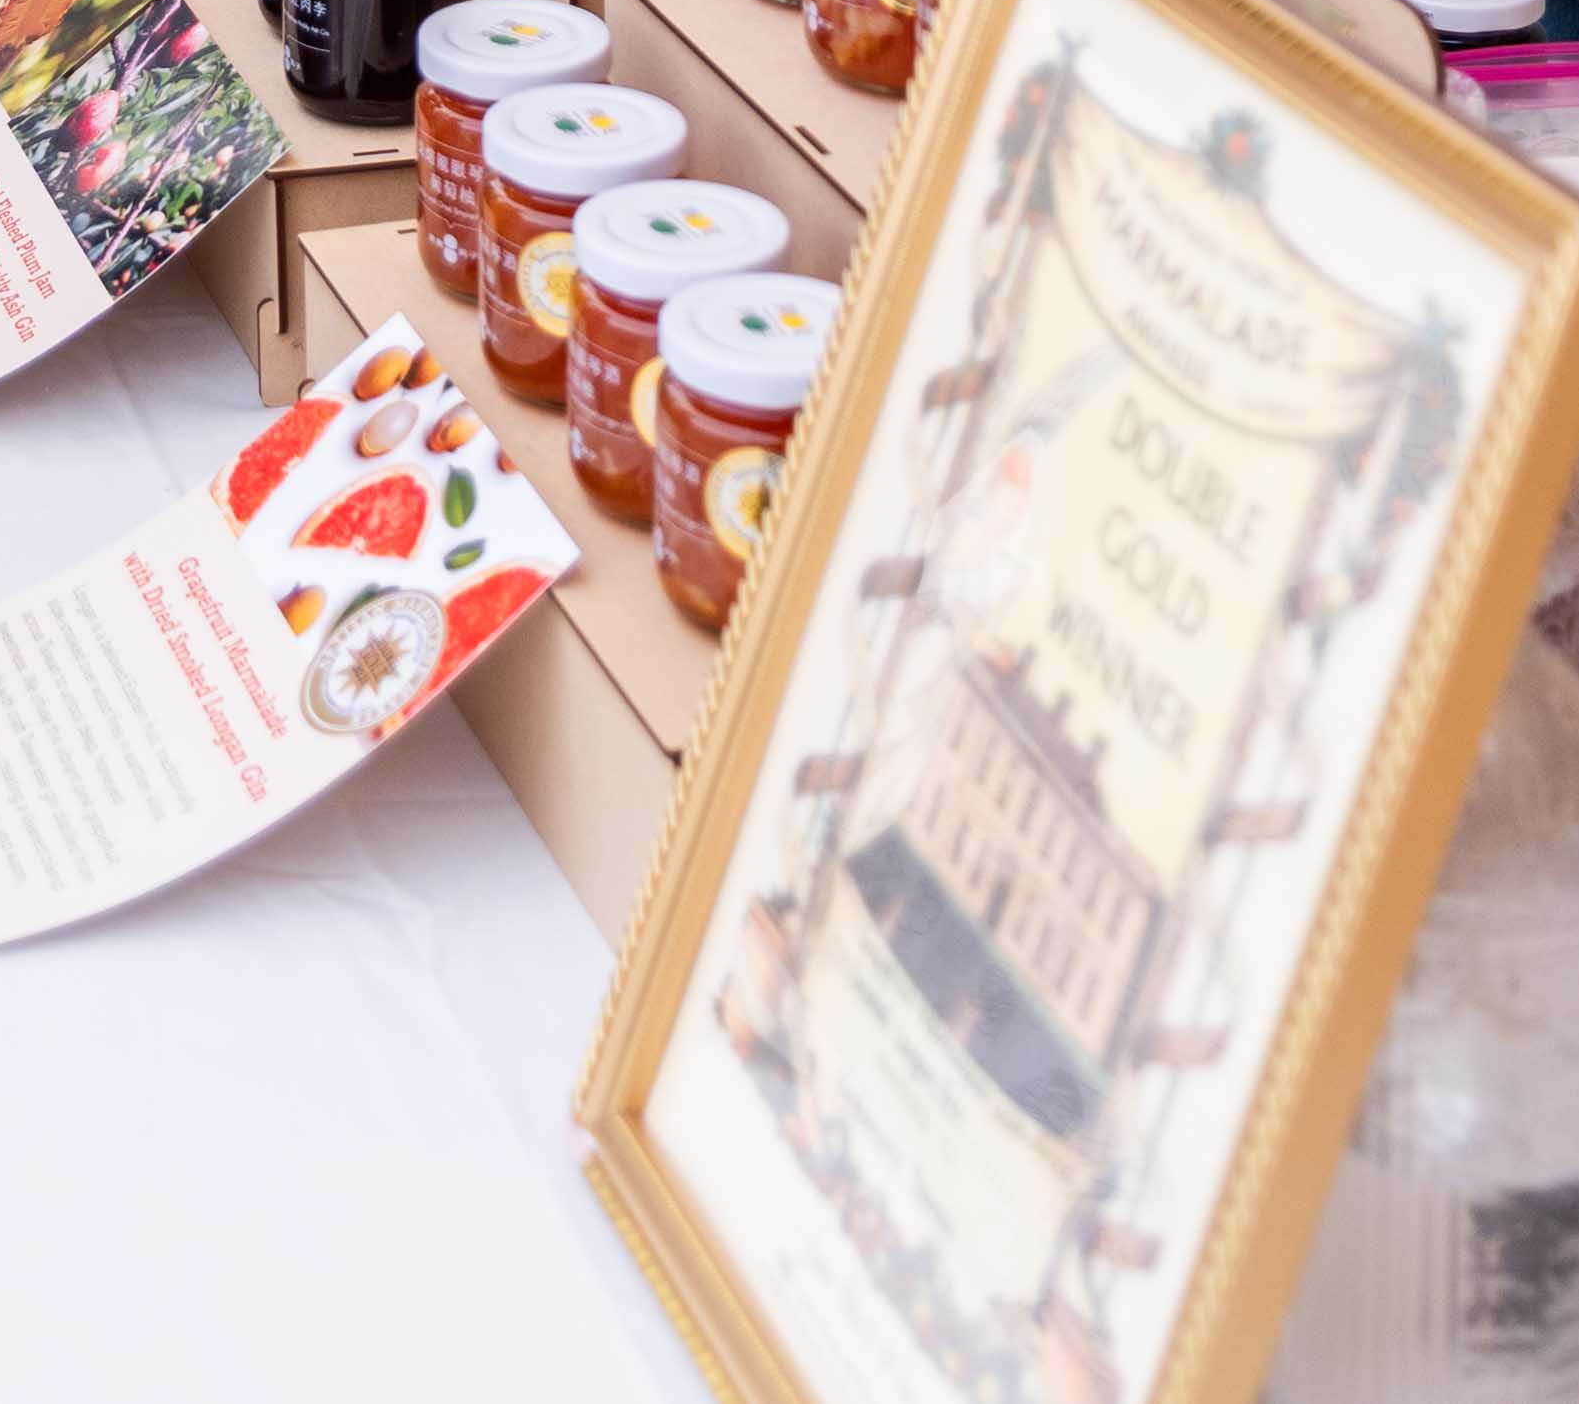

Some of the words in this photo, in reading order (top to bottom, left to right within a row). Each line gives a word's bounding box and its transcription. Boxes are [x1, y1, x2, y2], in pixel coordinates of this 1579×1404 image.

[16, 239, 42, 275] Plum
[27, 270, 55, 299] Jam
[0, 293, 25, 319] Ash
[14, 316, 36, 343] Gin
[178, 557, 234, 642] Grapefruit
[223, 637, 287, 739] Marmalade
[123, 552, 154, 589] with
[141, 585, 181, 634] Dried
[166, 632, 218, 699] Smoked
[201, 696, 247, 766] Longan
[239, 764, 267, 802] Gin
